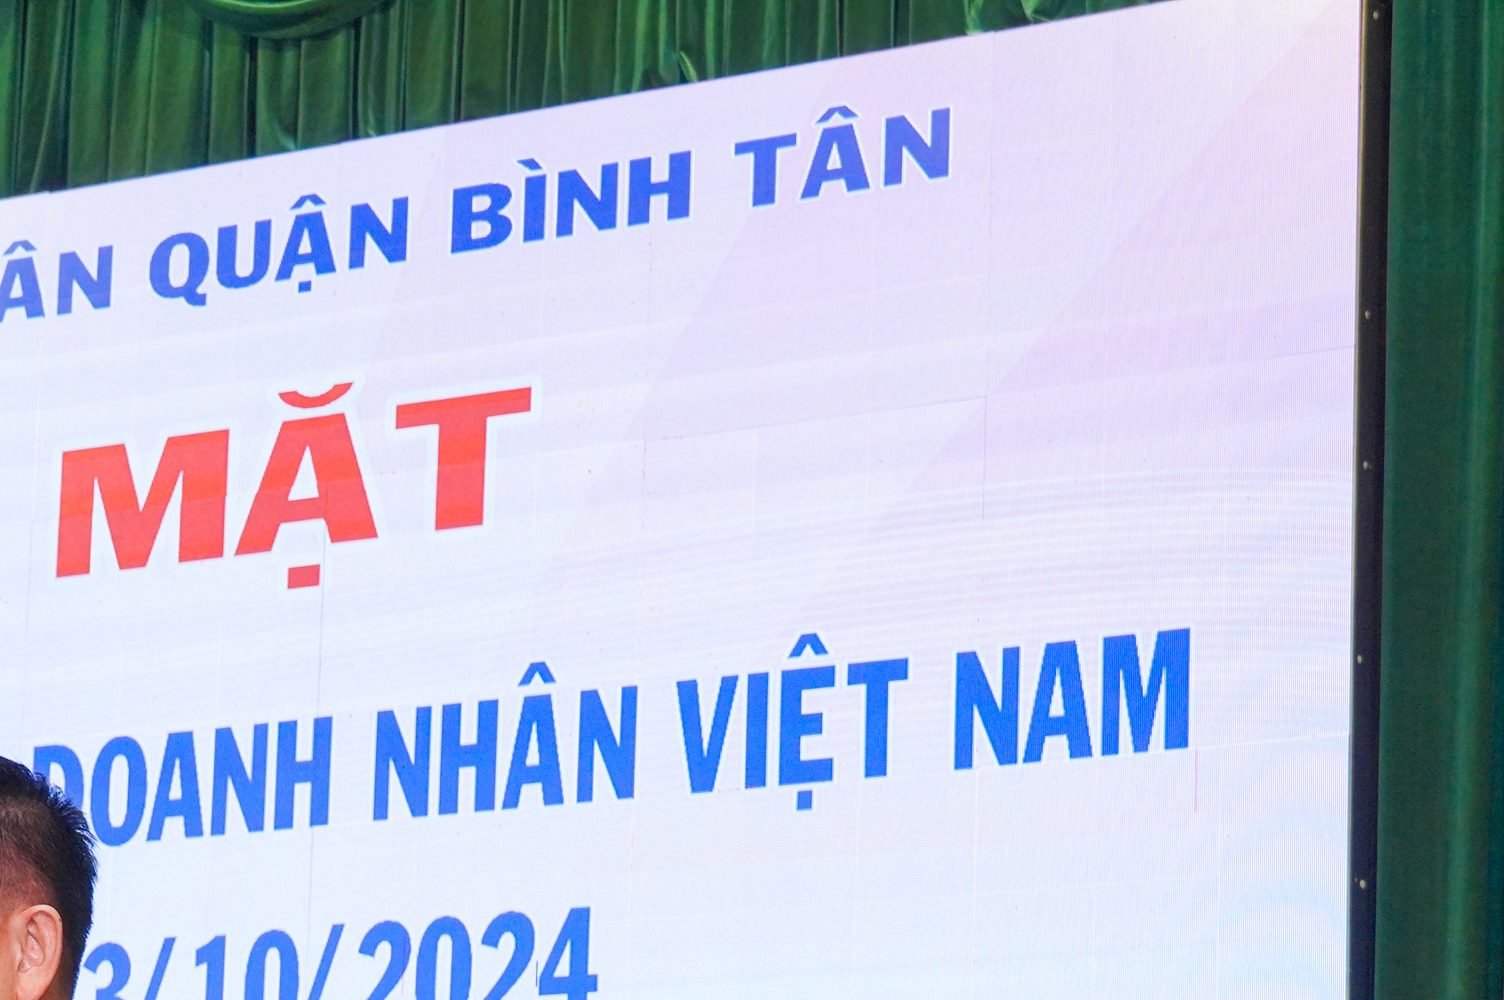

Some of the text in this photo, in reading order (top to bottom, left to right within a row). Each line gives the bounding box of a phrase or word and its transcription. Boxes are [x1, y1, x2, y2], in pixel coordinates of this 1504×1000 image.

[149, 193, 409, 308] QUẬN
[450, 150, 692, 256] BÌNH
[734, 105, 951, 208] TÂN
[56, 382, 532, 589] MẶT
[372, 661, 640, 822] NHÂN
[675, 632, 910, 813] VIỆT
[952, 626, 1191, 772] NAM
